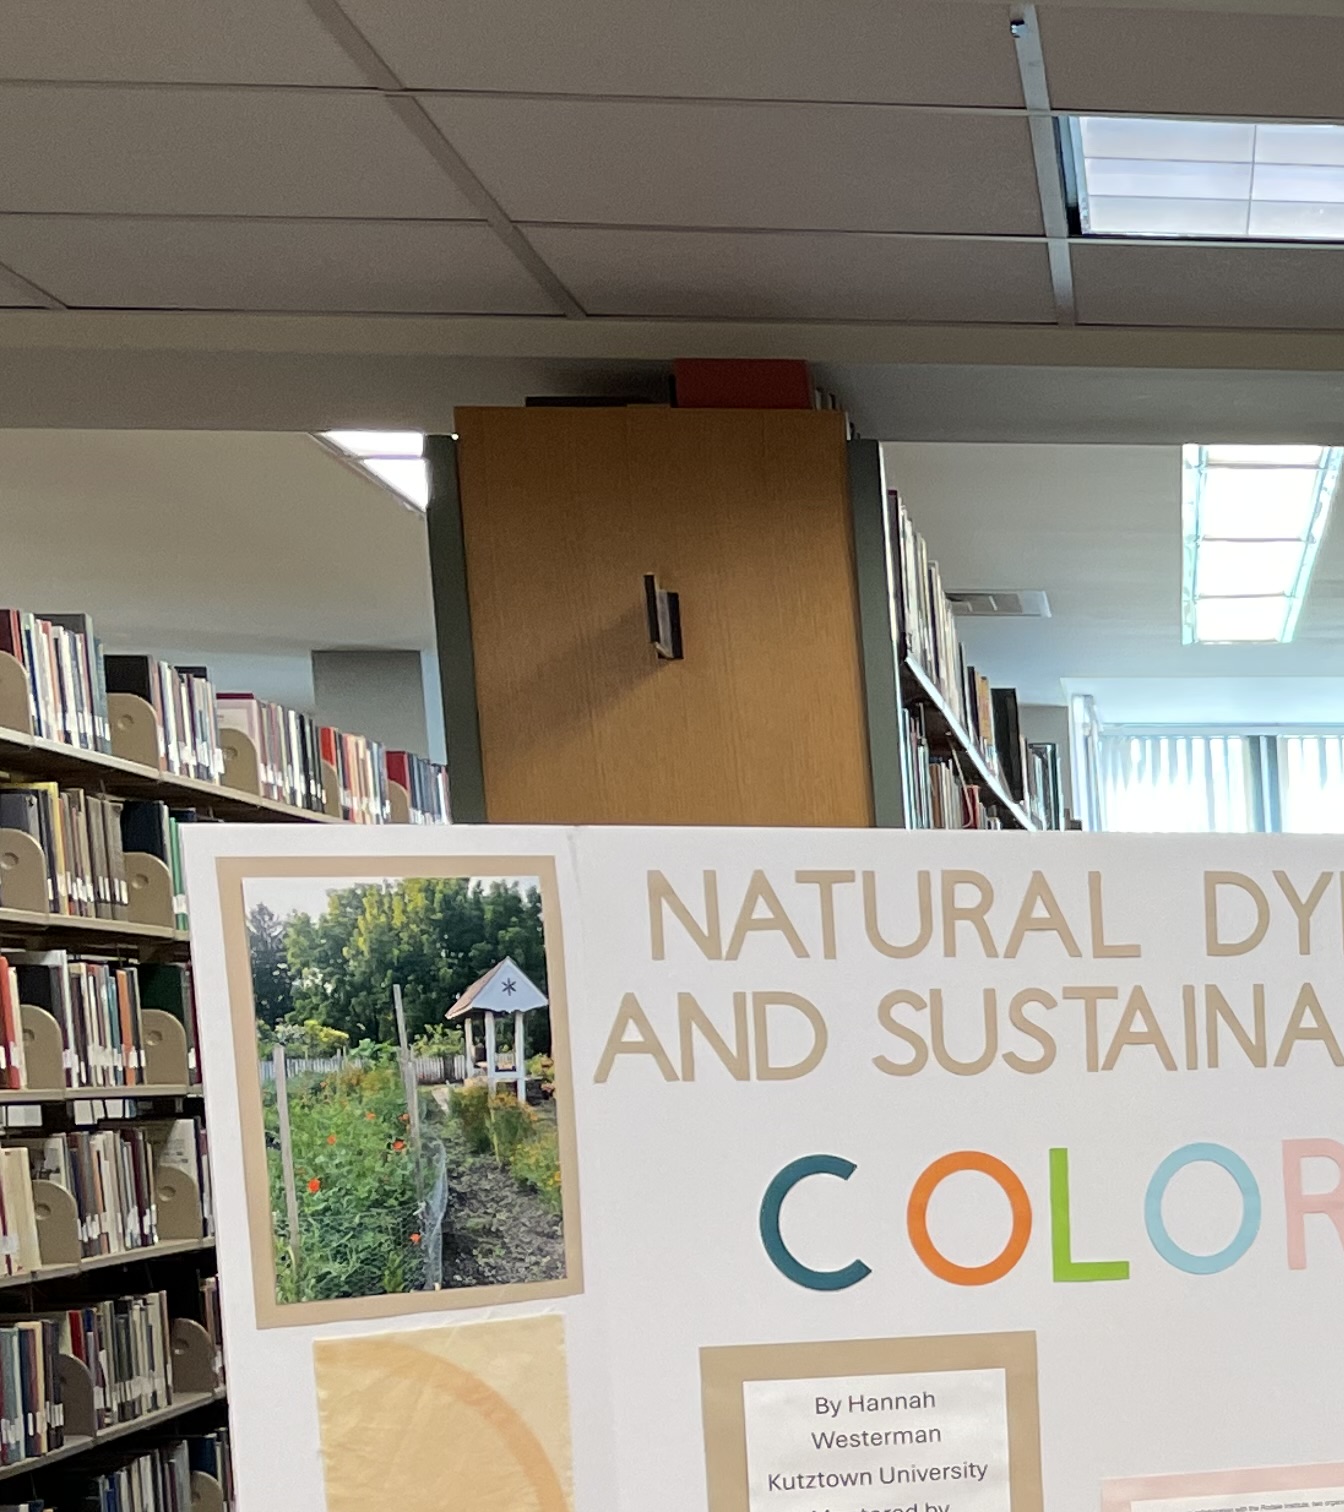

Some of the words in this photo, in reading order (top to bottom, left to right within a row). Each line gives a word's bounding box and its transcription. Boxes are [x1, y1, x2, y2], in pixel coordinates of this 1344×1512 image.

[647, 870, 1141, 961] NATURAL
[593, 992, 828, 1083] AND
[815, 1397, 842, 1418] By
[848, 1391, 936, 1413] Hannah
[811, 1426, 941, 1449] Westerman
[768, 1468, 872, 1492] Kutztown
[879, 1462, 988, 1485] University
